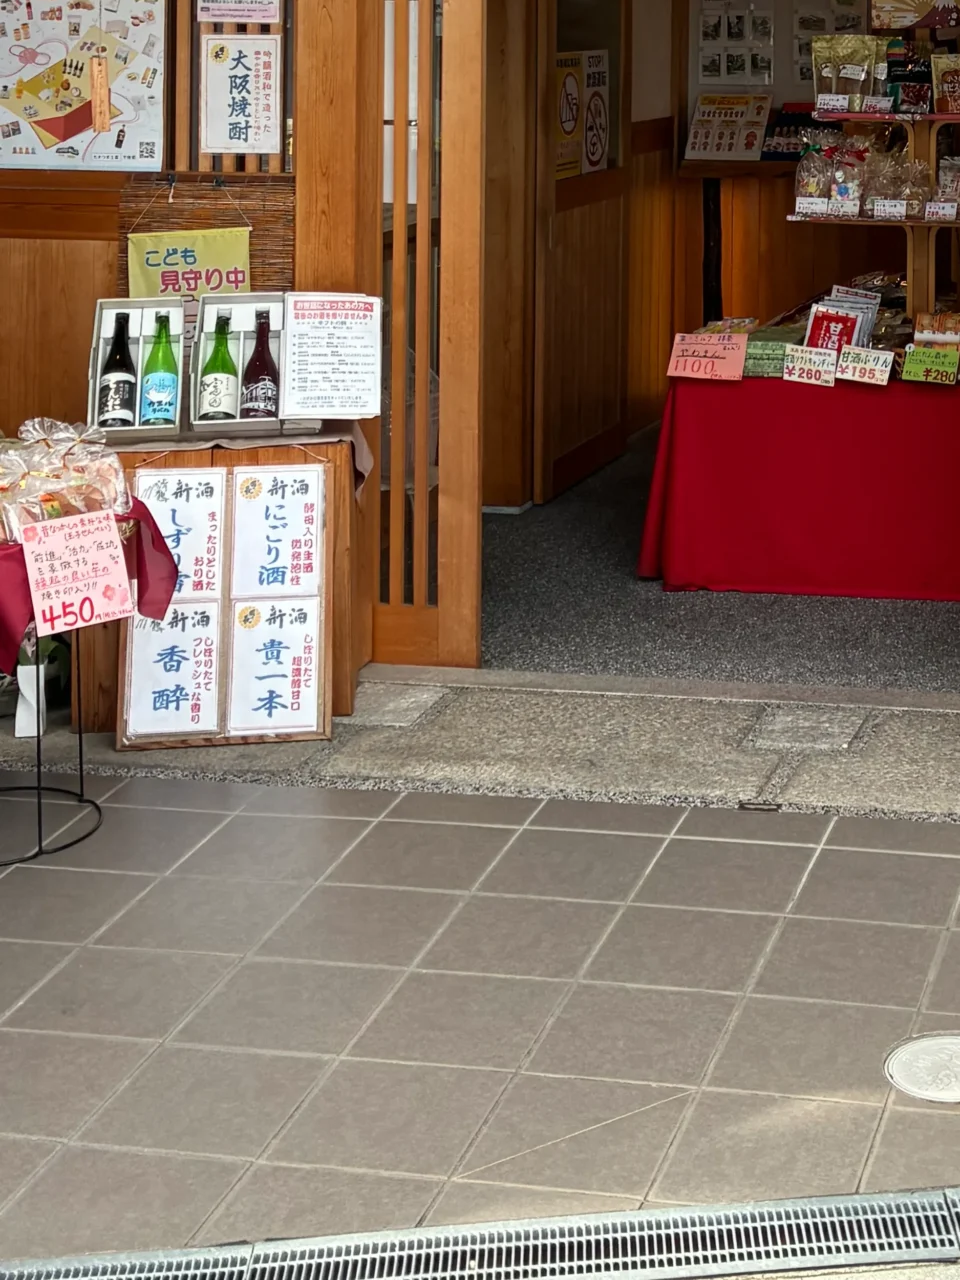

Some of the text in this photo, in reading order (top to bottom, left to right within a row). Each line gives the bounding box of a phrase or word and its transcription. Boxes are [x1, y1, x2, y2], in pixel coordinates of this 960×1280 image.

[228, 49, 253, 143] 大阪焼酎
[145, 247, 198, 268] こども
[160, 267, 246, 294] 見守り中
[785, 364, 823, 381] ¥260
[837, 363, 877, 380] ¥195
[922, 367, 956, 383] ¥280
[171, 479, 214, 503] 新酒
[267, 476, 310, 500] 新酒
[205, 510, 218, 592] まったりとした
[258, 503, 289, 587] にごり酒
[302, 502, 315, 574] 酵母入り生酒
[41, 596, 95, 631] 450
[167, 608, 211, 633] 新酒
[265, 605, 308, 629] 新酒
[152, 644, 190, 712] 香酔
[203, 636, 214, 691] しぼりたて
[251, 638, 290, 718] 貴一本
[302, 633, 314, 689] しぼりたて
[190, 637, 203, 724] フレッシュな香り
